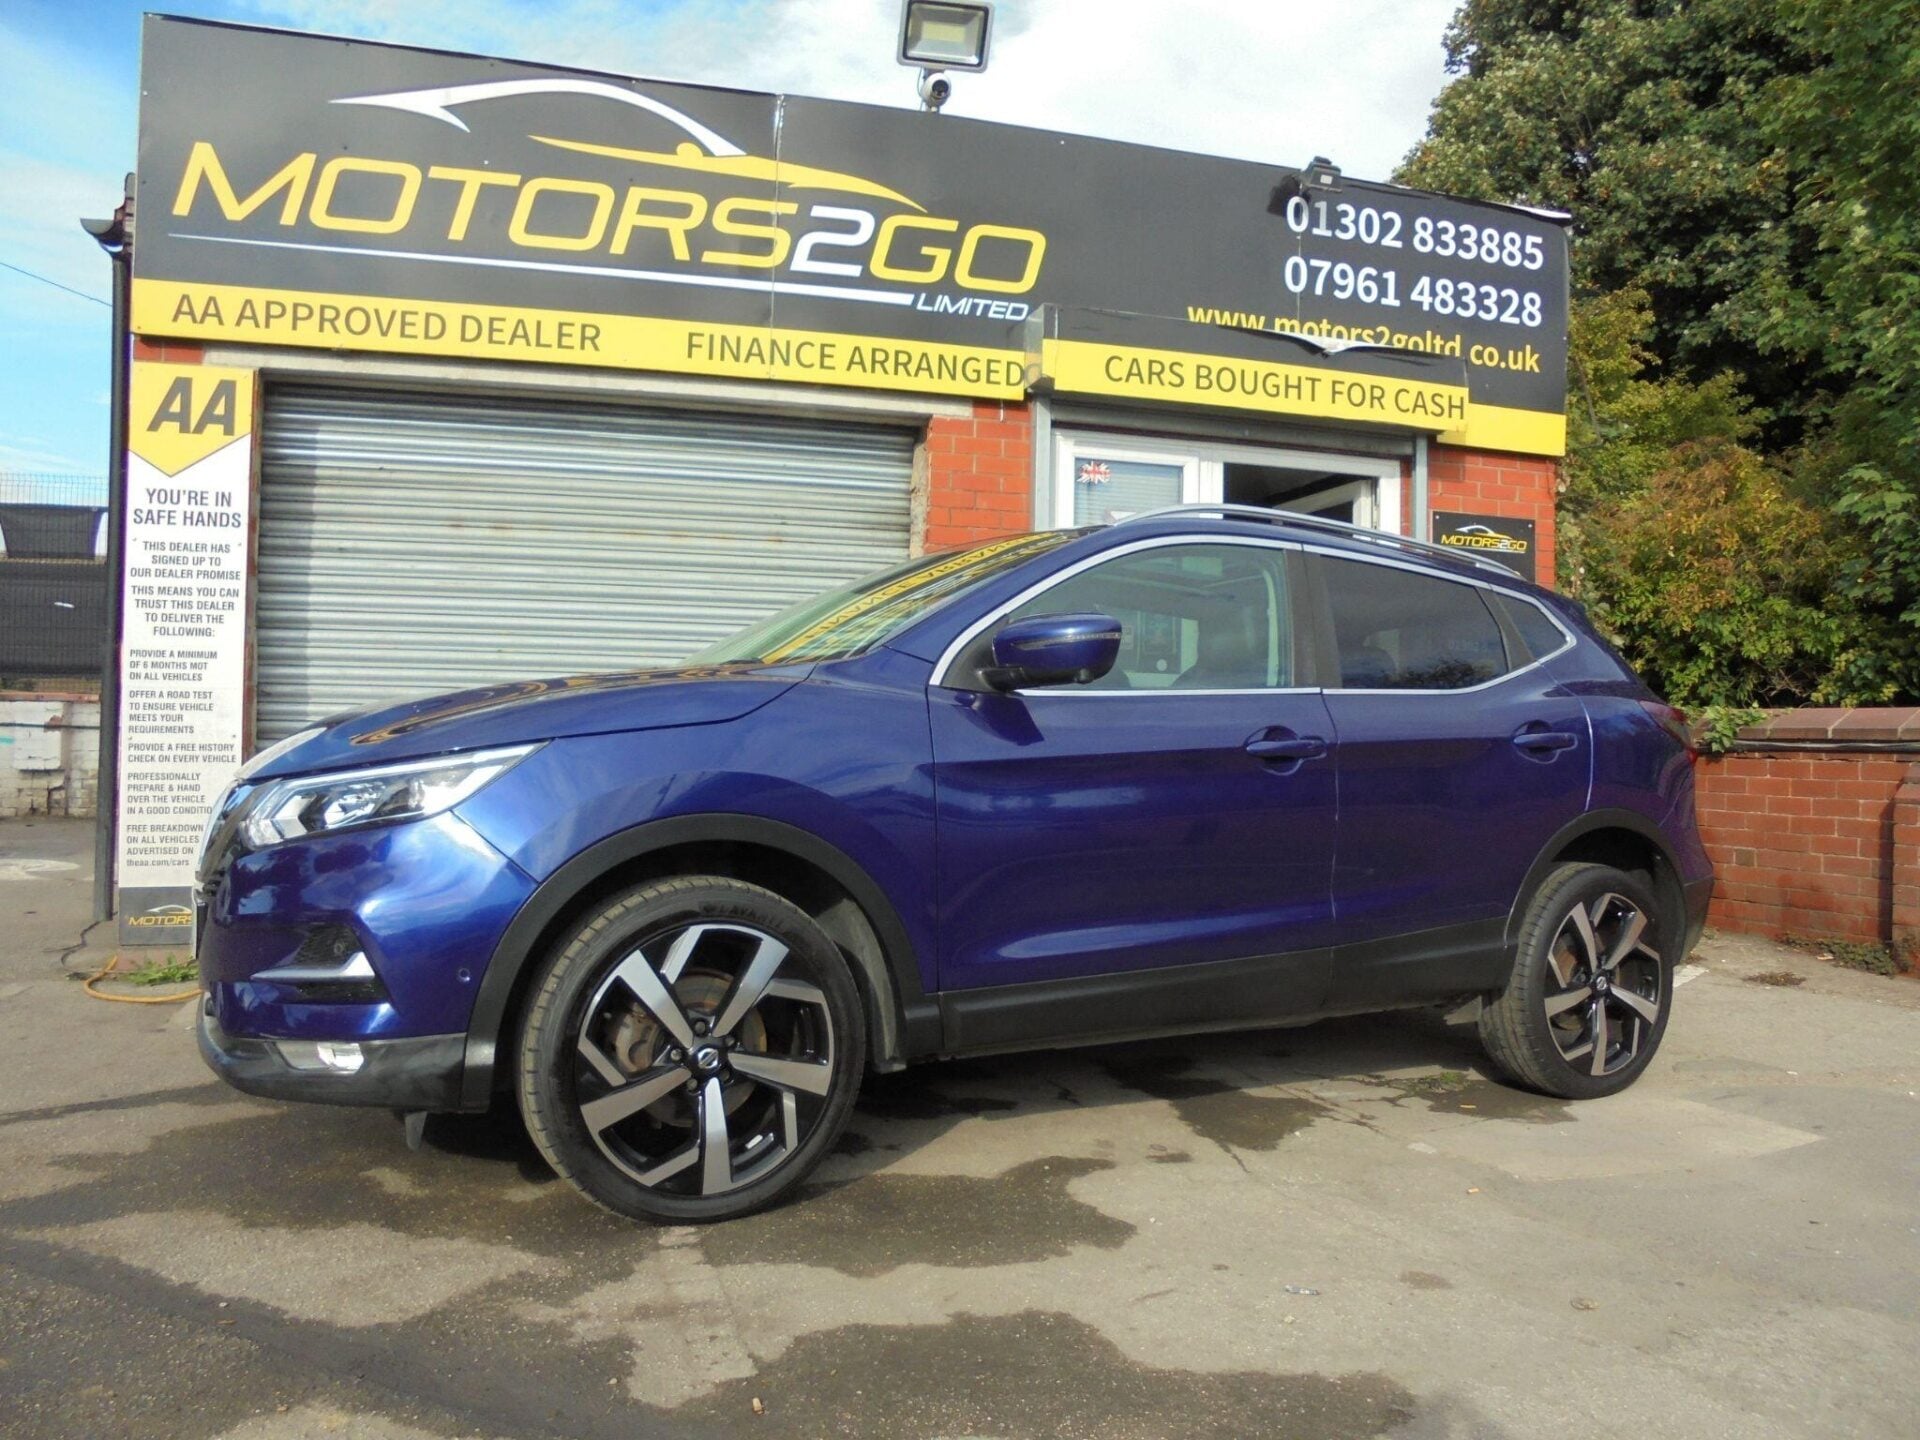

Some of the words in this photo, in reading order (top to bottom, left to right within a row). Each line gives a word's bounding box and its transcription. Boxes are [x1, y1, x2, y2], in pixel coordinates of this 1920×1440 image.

[170, 141, 1047, 294] MOTORS2GO
[1286, 195, 1402, 248] 01302
[1413, 216, 1544, 270] 833885
[1285, 256, 1400, 306] 07961
[1411, 276, 1542, 327] 483328
[916, 292, 1030, 323] LIMITED
[172, 293, 223, 325] AA
[233, 299, 449, 342] APPROVED
[459, 313, 602, 352] DEALER
[1187, 306, 1540, 373] wwwmotors2goltdco.uk
[686, 333, 836, 373] FINANCE
[847, 344, 1027, 388] ARRANGED
[1104, 355, 1184, 389] CARS
[1195, 363, 1322, 405] BOUGHT
[1330, 379, 1384, 412] FOR
[1394, 388, 1465, 420] CASH
[146, 376, 236, 436] AA
[146, 488, 208, 506] YOU'RE
[215, 490, 232, 507] IN
[133, 508, 176, 526] SAFE
[182, 510, 241, 528] HANDS
[143, 541, 165, 552] THIS
[169, 542, 207, 552] DEALER
[210, 542, 230, 553] HAS
[1440, 534, 1528, 551] MOTORS2GO
[152, 555, 188, 566] SIGNED
[192, 556, 206, 566] UP
[208, 556, 221, 566] TO
[130, 567, 152, 578] OUR
[155, 568, 193, 579] DEALER
[196, 569, 240, 580] PROMISE
[132, 585, 154, 596] THIS
[158, 586, 193, 598] MEANS
[196, 586, 216, 598] YOU
[220, 587, 239, 598] CAN
[136, 598, 168, 609] TRUST
[171, 599, 193, 610] THIS
[196, 600, 234, 611] DEALER
[145, 612, 158, 622] TO
[162, 612, 203, 624] DELIVER
[206, 614, 224, 624] THE
[153, 626, 215, 638] FOLLOWING:
[130, 649, 166, 658] PROVIDE
[169, 650, 176, 658] A
[178, 650, 218, 660] MINIMUM
[130, 661, 141, 670] OF
[144, 661, 148, 670] 6
[150, 662, 187, 670] MONTHS
[190, 662, 208, 670] MOT
[130, 672, 142, 681] ON
[144, 673, 159, 682] ALL
[162, 672, 202, 682] VEHICLES
[129, 690, 156, 700] OFFER
[158, 690, 164, 700] A
[167, 690, 190, 700] ROAD
[192, 691, 213, 700] TEST
[129, 702, 140, 711] TO
[143, 702, 176, 712] ENSURE
[179, 702, 214, 712] VEHICLE
[129, 713, 157, 722] MEETS
[160, 714, 184, 722] YOUR
[128, 725, 194, 734] REQUIREMENTS
[128, 742, 165, 752] PROVIDE
[168, 743, 174, 752] A
[176, 743, 197, 752] FREE
[199, 744, 234, 752] HISTORY
[128, 754, 156, 762] CHECK
[158, 754, 170, 762] ON
[174, 754, 200, 763] EVERY
[203, 754, 236, 764] VEHICLE
[128, 772, 200, 782] PROFESSIONALLY
[128, 784, 165, 792] PREPARE
[168, 784, 174, 792] &
[177, 784, 200, 792] HAND
[128, 795, 150, 804] OVER
[152, 795, 168, 804] THE
[171, 795, 206, 804] VEHICLE
[127, 806, 136, 815] IN
[138, 806, 144, 815] A
[146, 806, 170, 816] GOOD
[126, 824, 148, 833] FREE
[150, 824, 204, 834] BREAKDOWN
[126, 836, 138, 844] ON
[141, 836, 156, 844] ALL
[159, 836, 200, 844] VEHICLES
[126, 847, 178, 856] ADVERTISED
[182, 847, 194, 856] ON
[126, 858, 190, 868] theaa.com/cars
